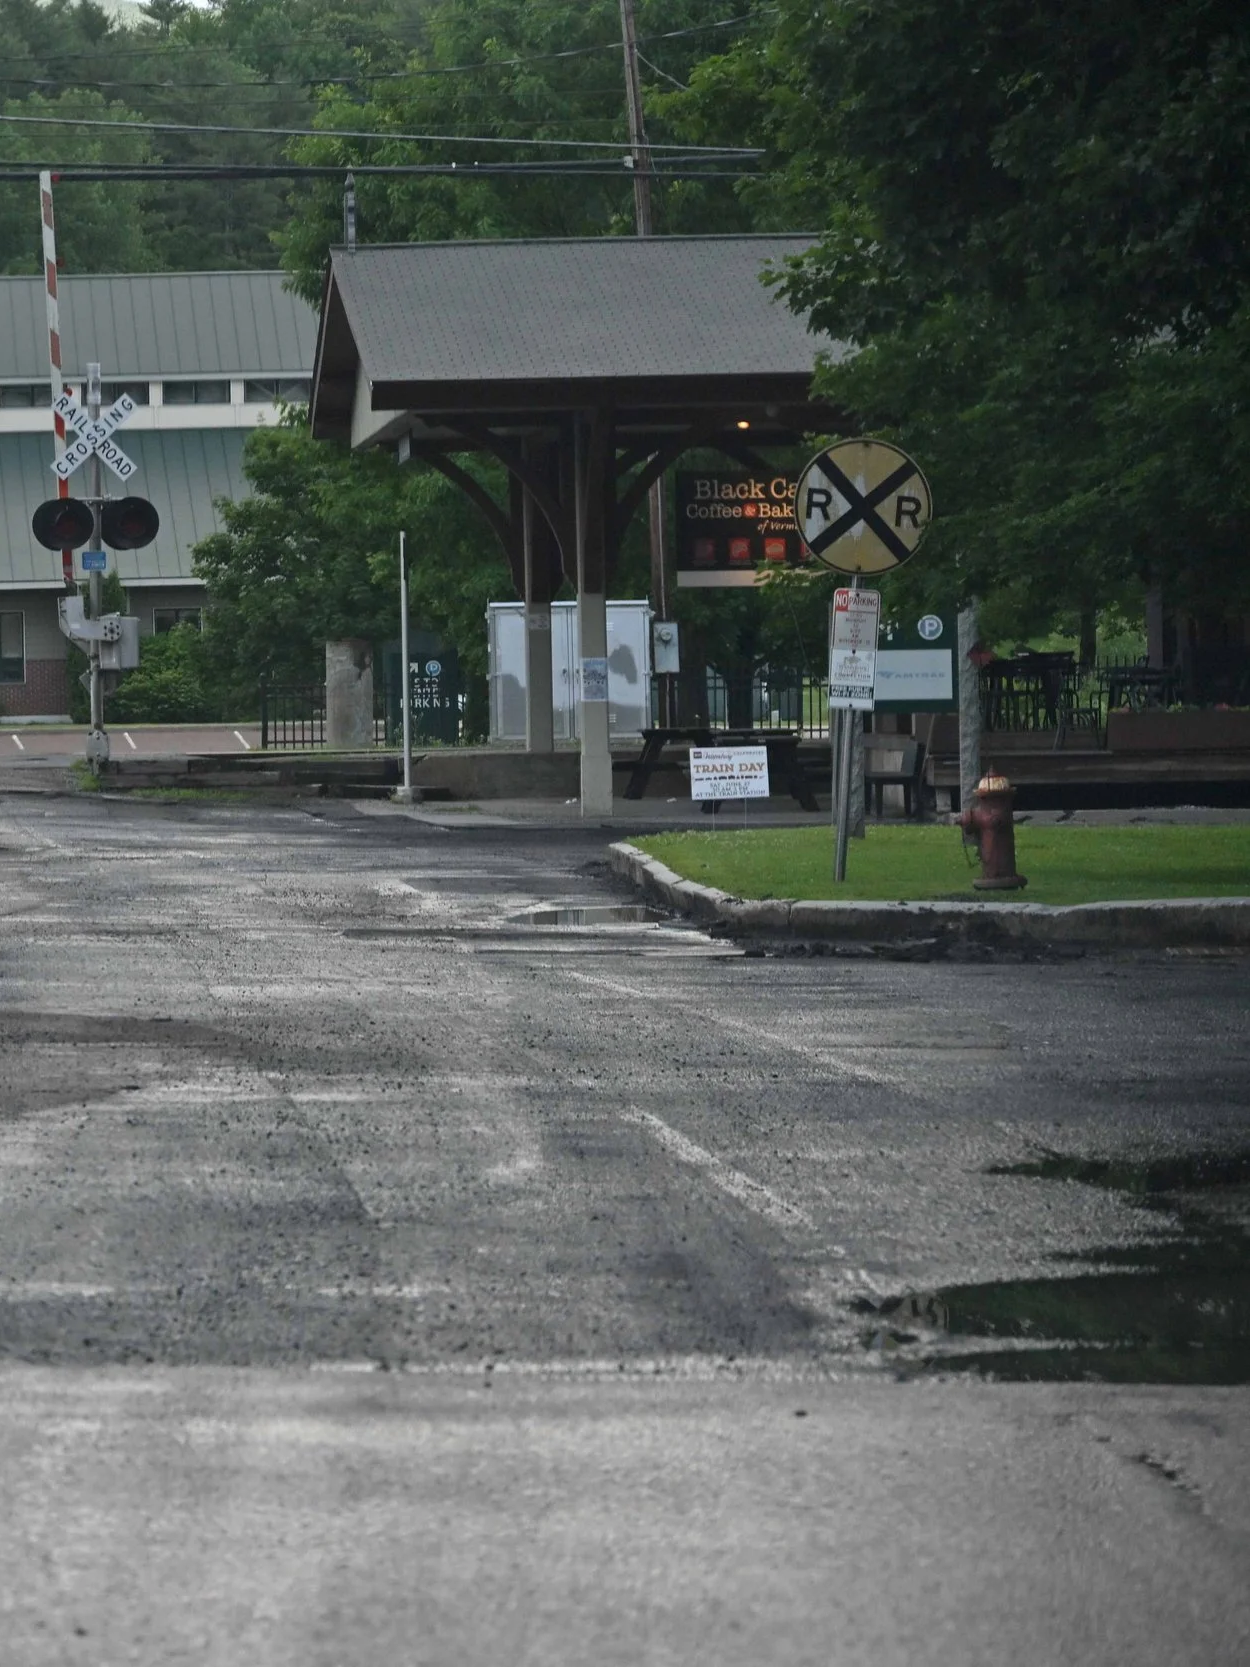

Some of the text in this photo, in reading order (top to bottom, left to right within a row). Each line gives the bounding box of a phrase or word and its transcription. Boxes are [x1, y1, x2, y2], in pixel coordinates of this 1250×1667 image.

[56, 398, 133, 475] CROSSING
[695, 478, 797, 499] Black Ca
[686, 503, 742, 518] Coffee
[758, 502, 795, 518] Bak
[806, 487, 832, 520] R
[895, 495, 922, 528] R
[757, 520, 798, 535] of Verm
[836, 594, 877, 607] NO PARKING
[925, 619, 938, 636] P
[693, 762, 765, 773] TRAIN DAY
